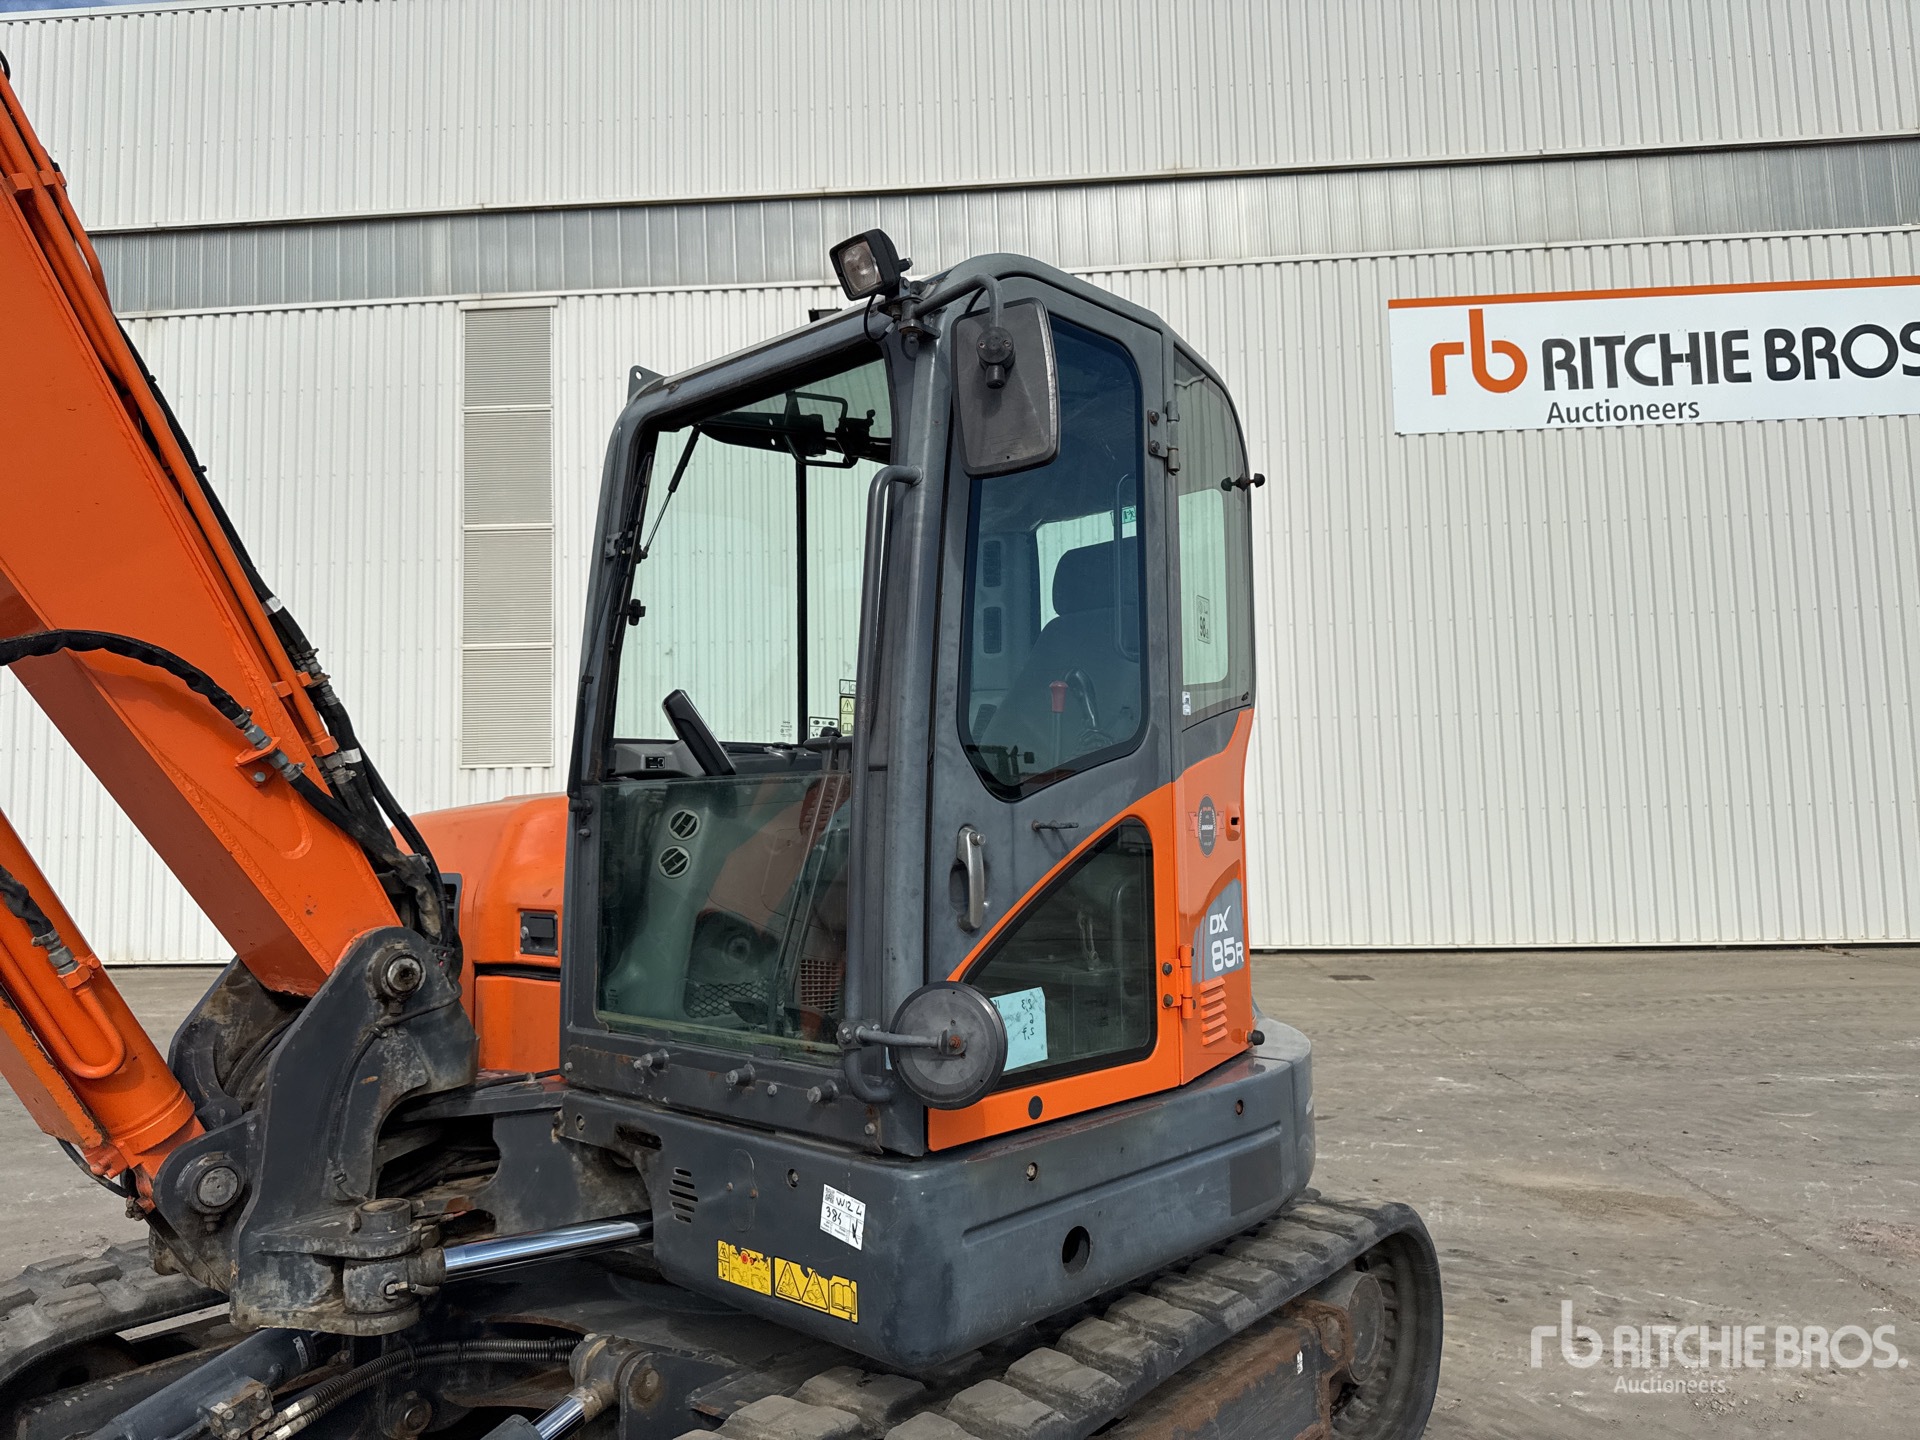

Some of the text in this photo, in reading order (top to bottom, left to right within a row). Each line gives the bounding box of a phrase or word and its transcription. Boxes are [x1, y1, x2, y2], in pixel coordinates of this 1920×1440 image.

[1541, 329, 1752, 392] RITCHIE
[1546, 399, 1700, 425] Auctioneers
[1209, 905, 1231, 935] DX
[1211, 936, 1244, 972] 85R
